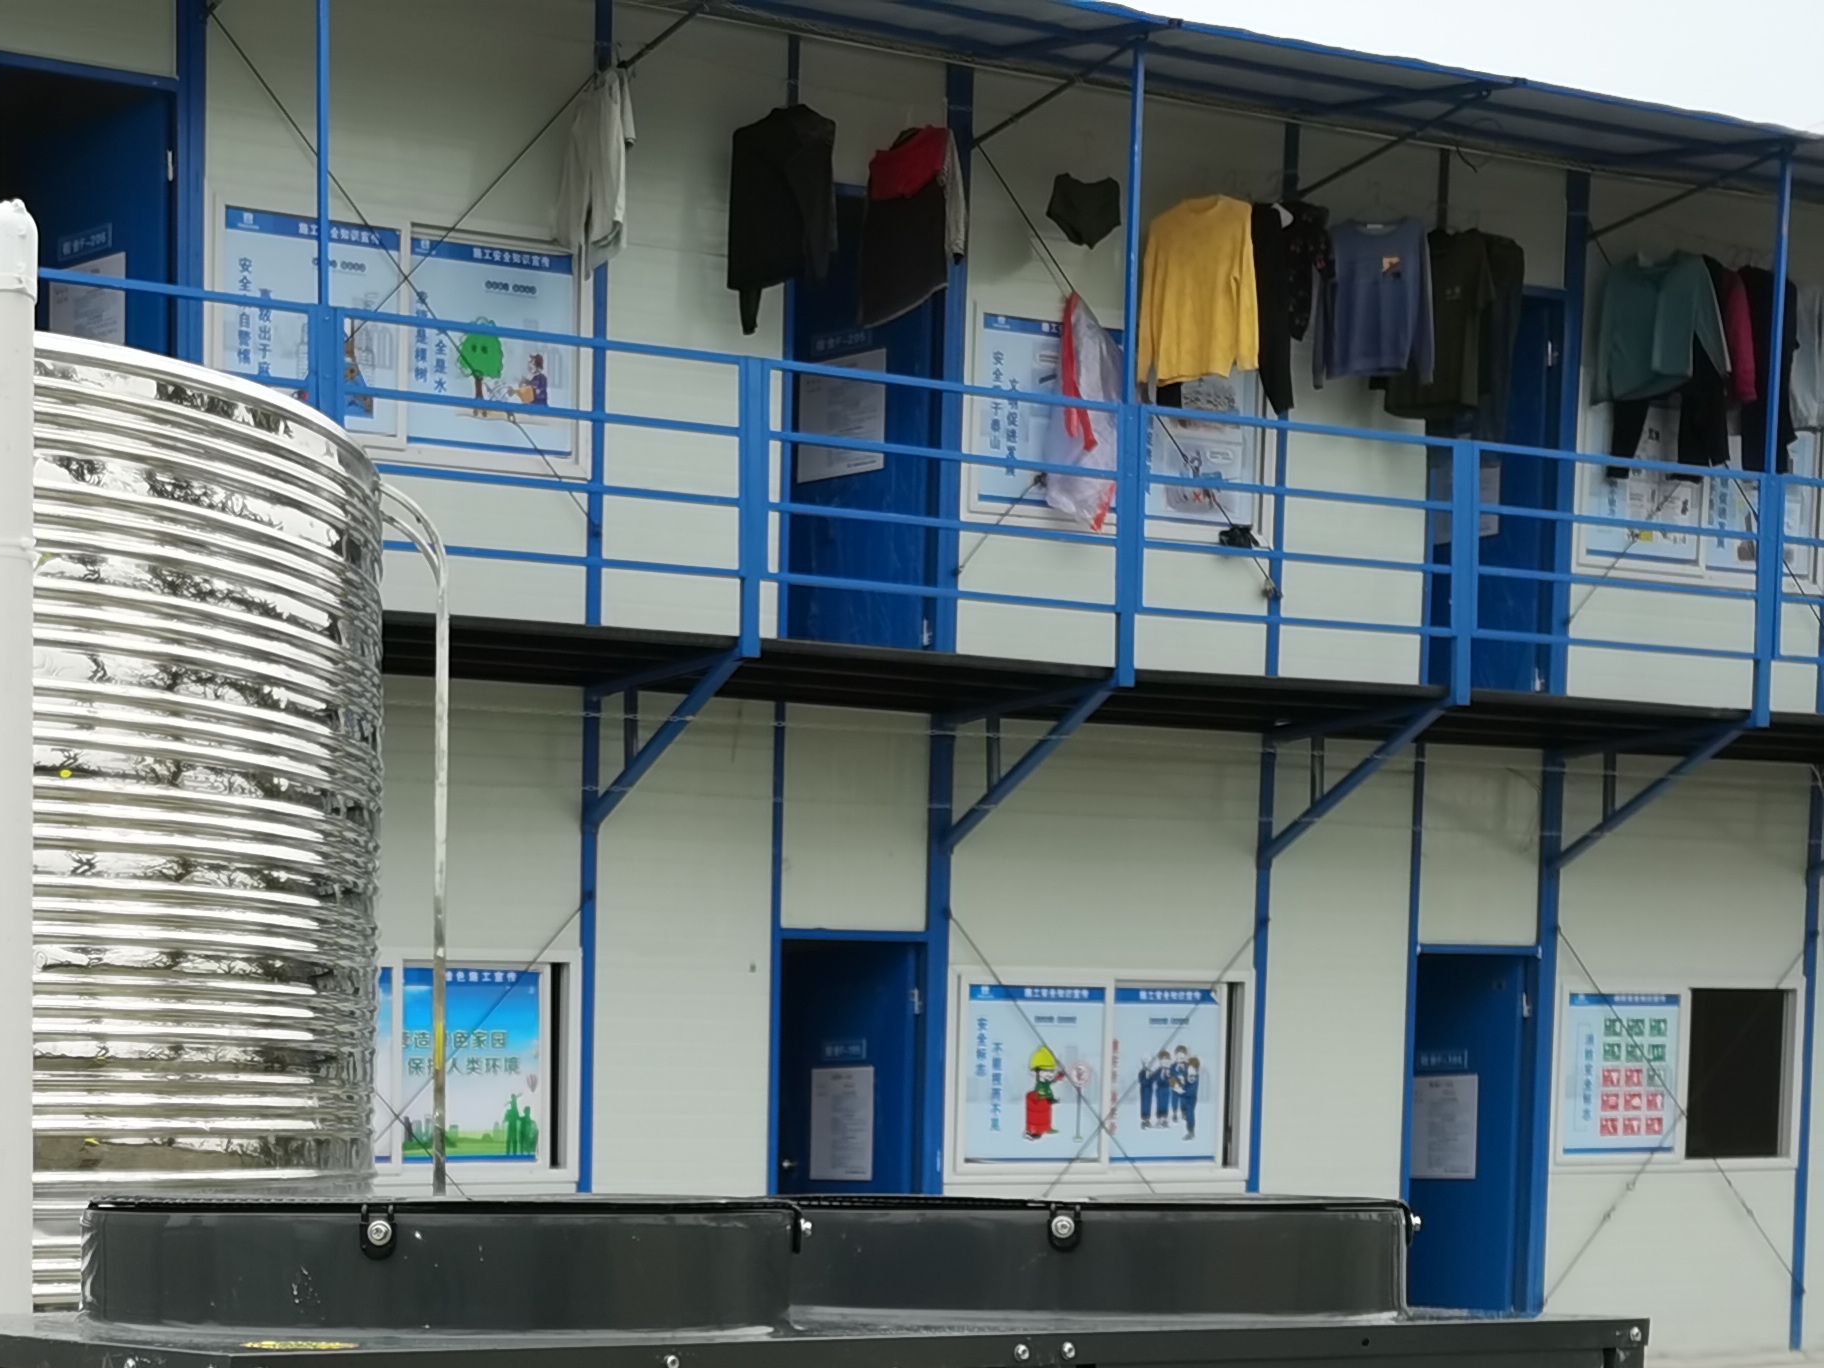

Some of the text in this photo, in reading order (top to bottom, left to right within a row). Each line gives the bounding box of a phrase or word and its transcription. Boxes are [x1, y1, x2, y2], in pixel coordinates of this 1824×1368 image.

[298, 222, 380, 246] 施工全知识宣传
